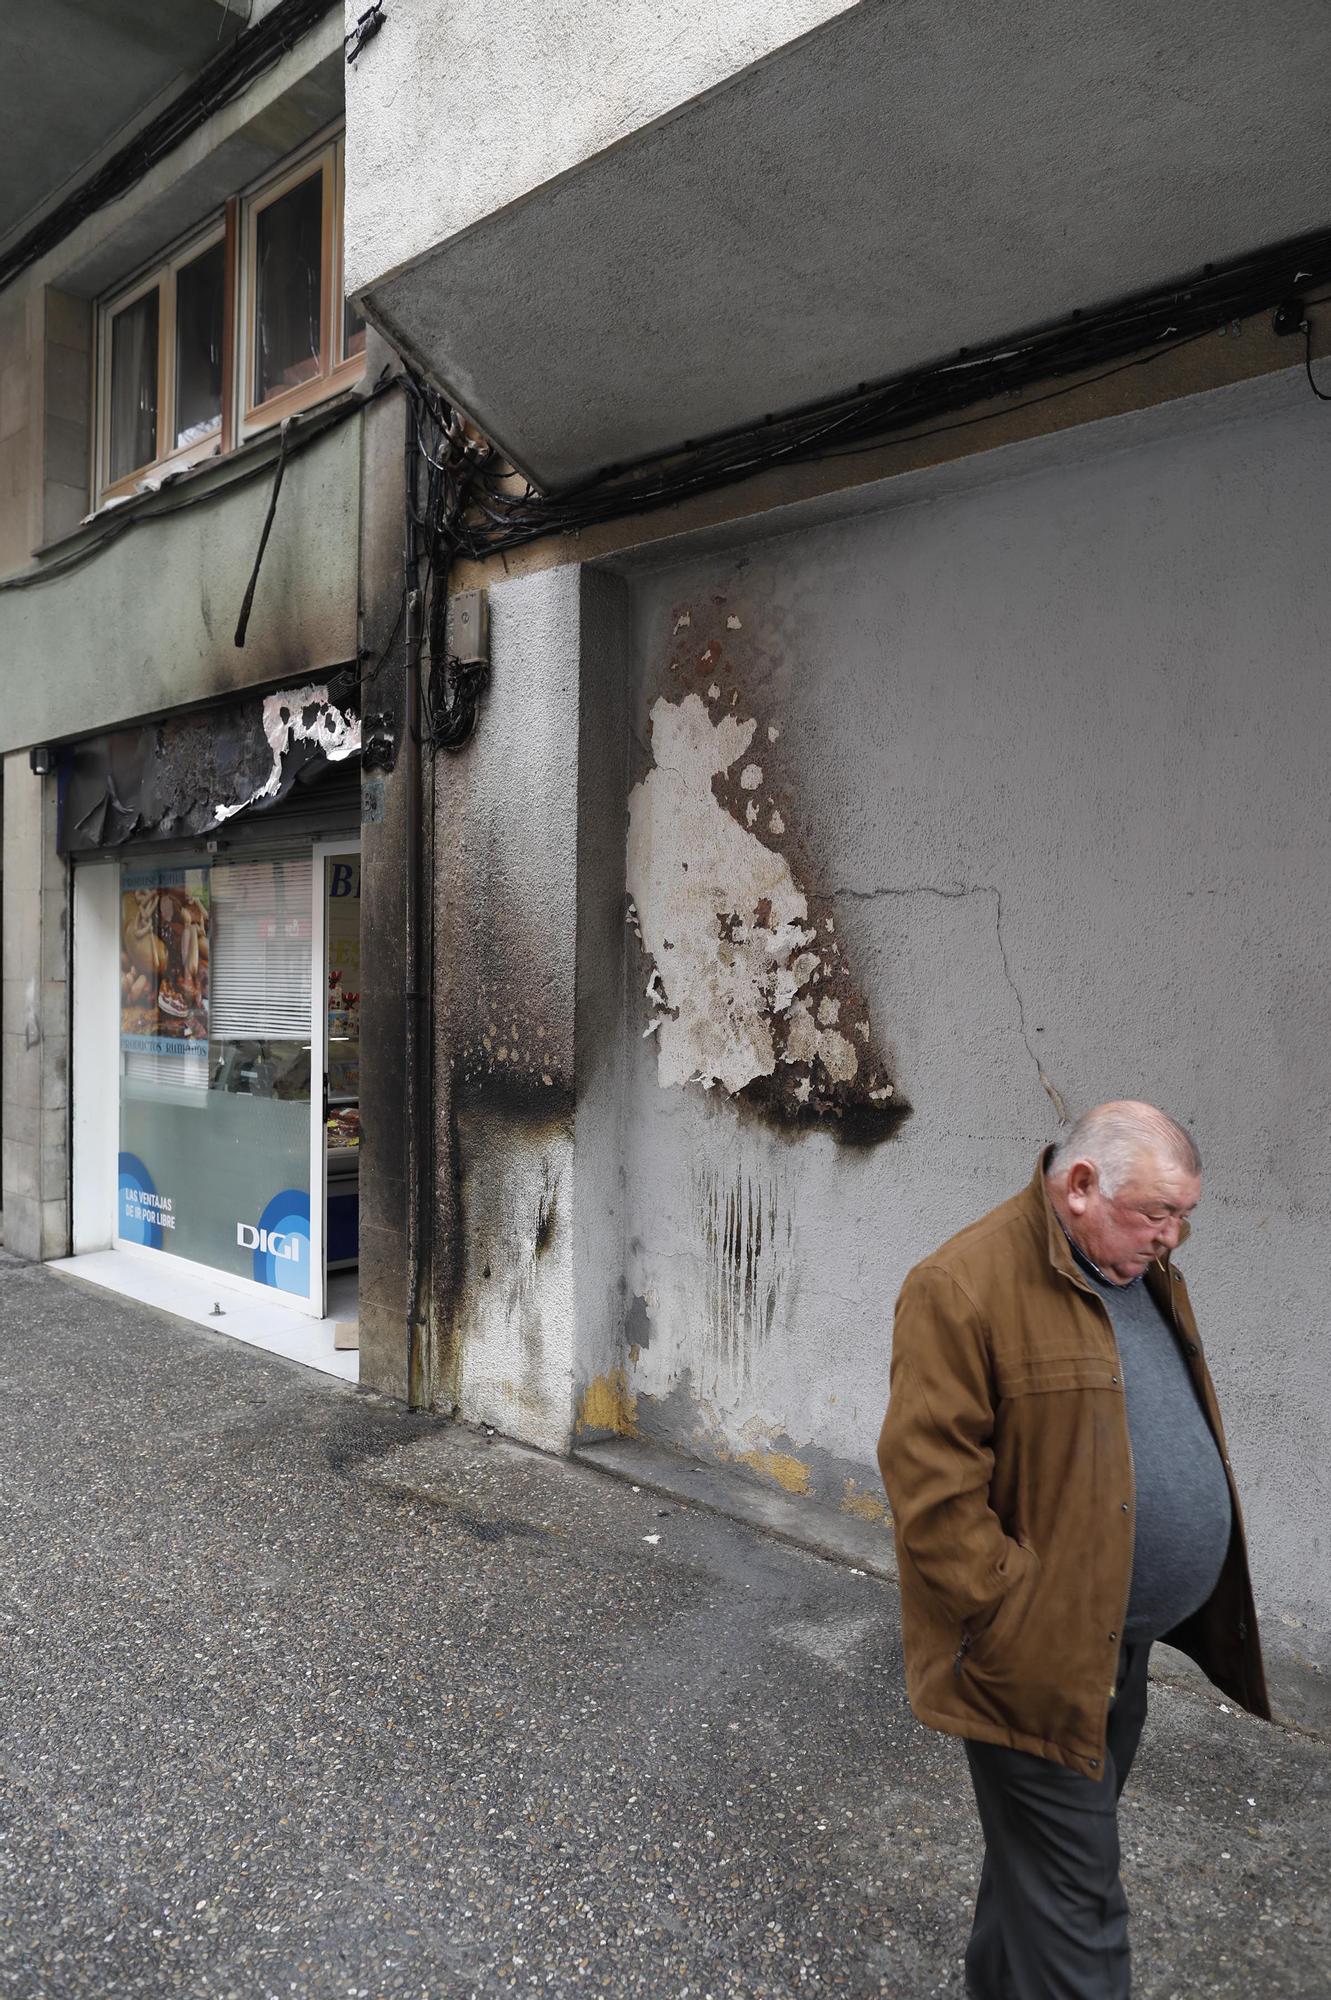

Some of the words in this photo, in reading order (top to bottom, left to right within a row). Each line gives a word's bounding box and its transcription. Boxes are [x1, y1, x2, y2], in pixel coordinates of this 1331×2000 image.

[125, 1188, 138, 1202] LAS
[138, 1191, 172, 1211] VENTAJAS
[125, 1204, 134, 1217] DE
[142, 1208, 156, 1224] POR
[156, 1212, 176, 1230] LIBRE
[236, 1222, 299, 1262] DIGI
